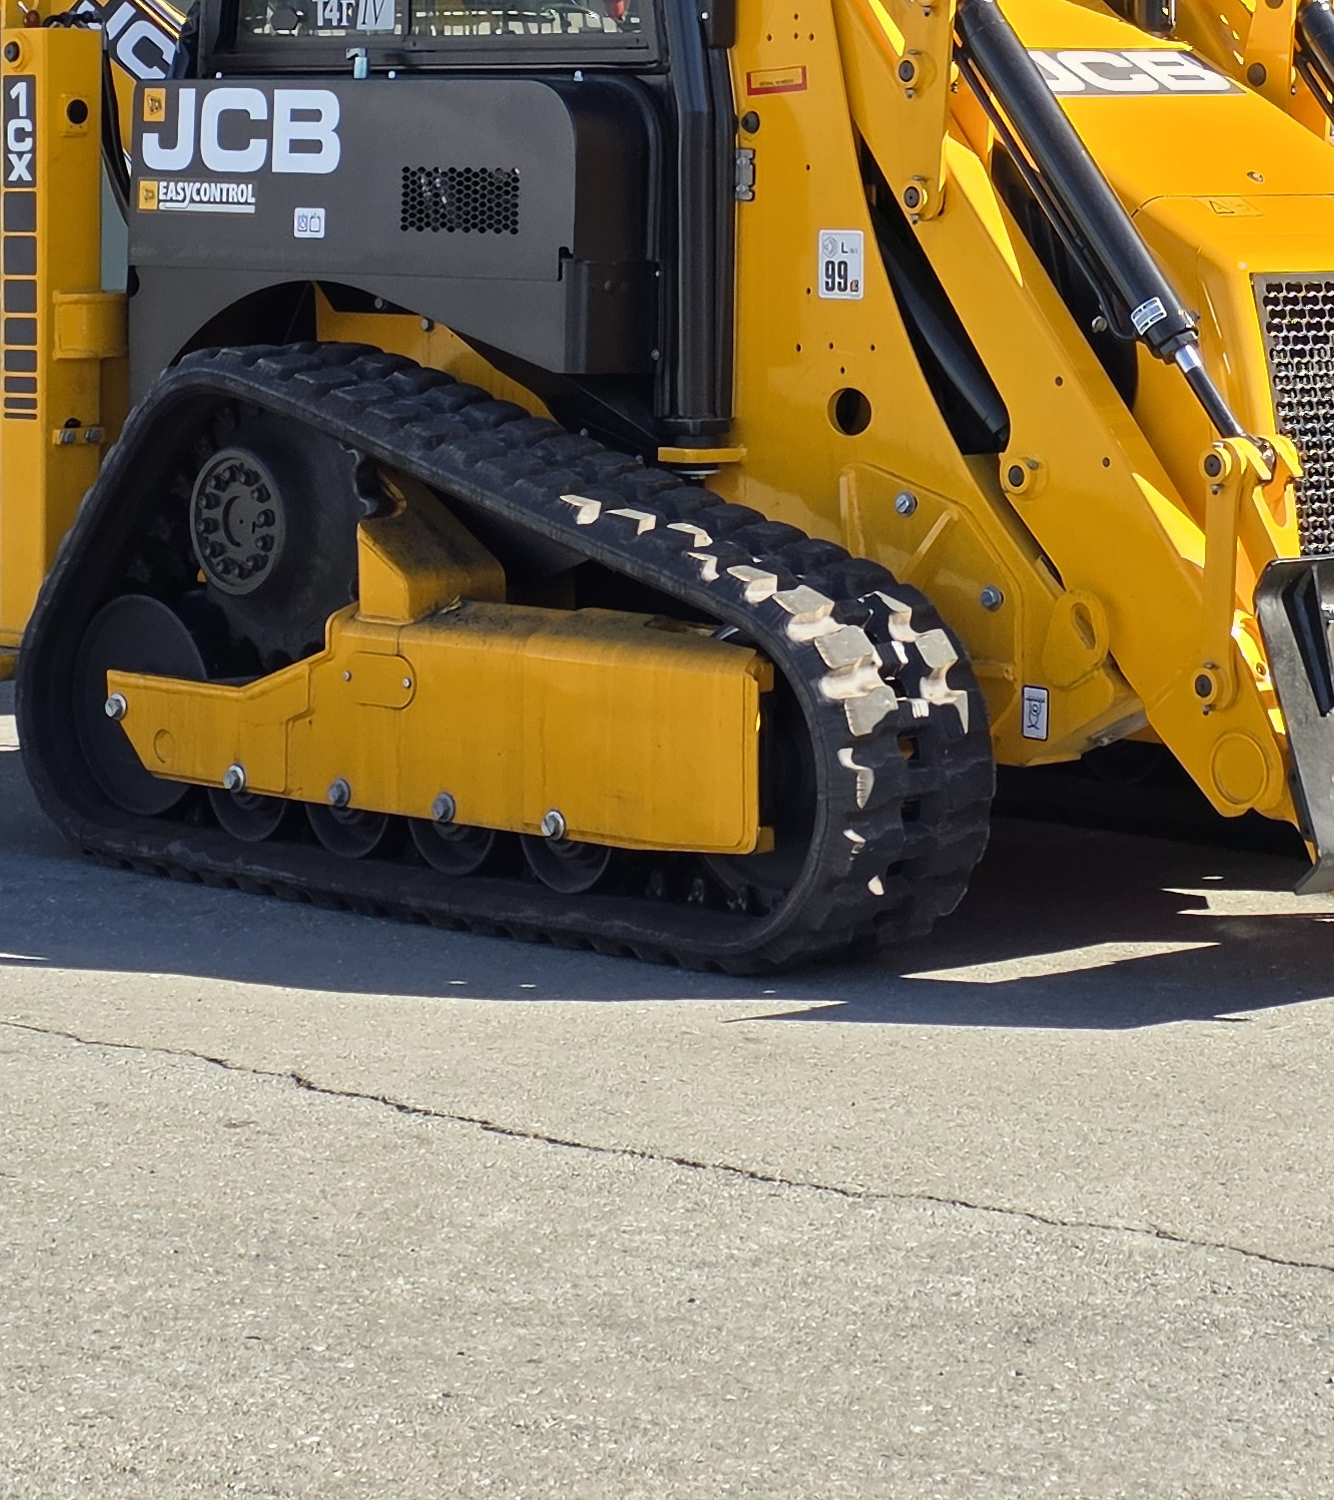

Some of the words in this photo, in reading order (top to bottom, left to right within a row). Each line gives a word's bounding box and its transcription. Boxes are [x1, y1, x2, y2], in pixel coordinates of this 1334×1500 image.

[7, 81, 33, 181] 1CX
[142, 87, 341, 174] JCB
[158, 181, 256, 206] EASYCONTROL
[825, 260, 848, 292] 99
